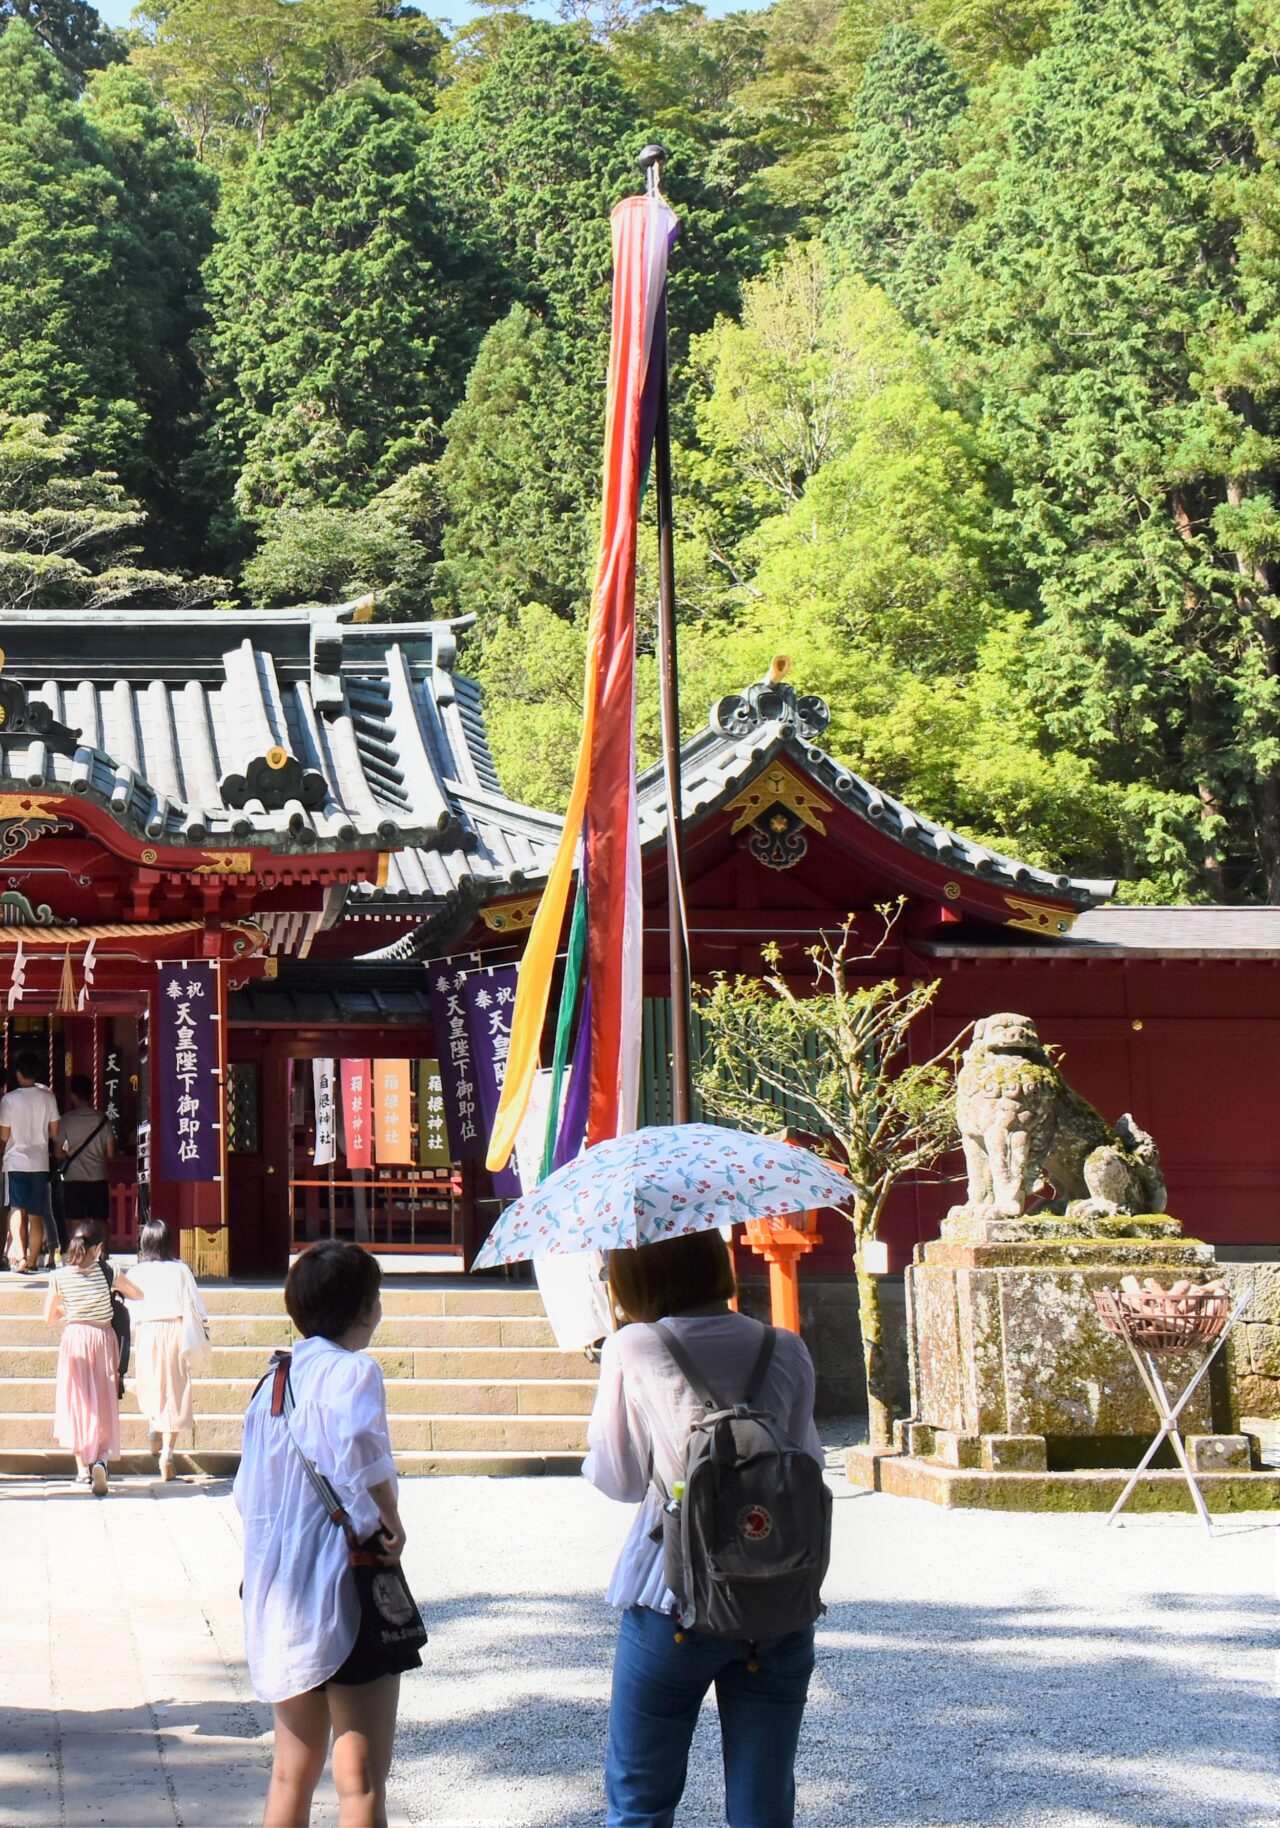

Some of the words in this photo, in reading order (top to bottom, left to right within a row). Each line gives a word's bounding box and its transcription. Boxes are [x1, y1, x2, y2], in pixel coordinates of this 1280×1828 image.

[166, 980, 204, 1000] 奉祝
[475, 987, 516, 1010] 奉祝
[174, 1002, 200, 1162] 天皇陛下御即位
[446, 994, 477, 1141] 天皇陛下御即位
[319, 1073, 332, 1145] 箱根神社
[350, 1075, 364, 1150] 箱根神社
[383, 1074, 400, 1145] 箱根神社
[427, 1075, 444, 1150] 箱根神社
